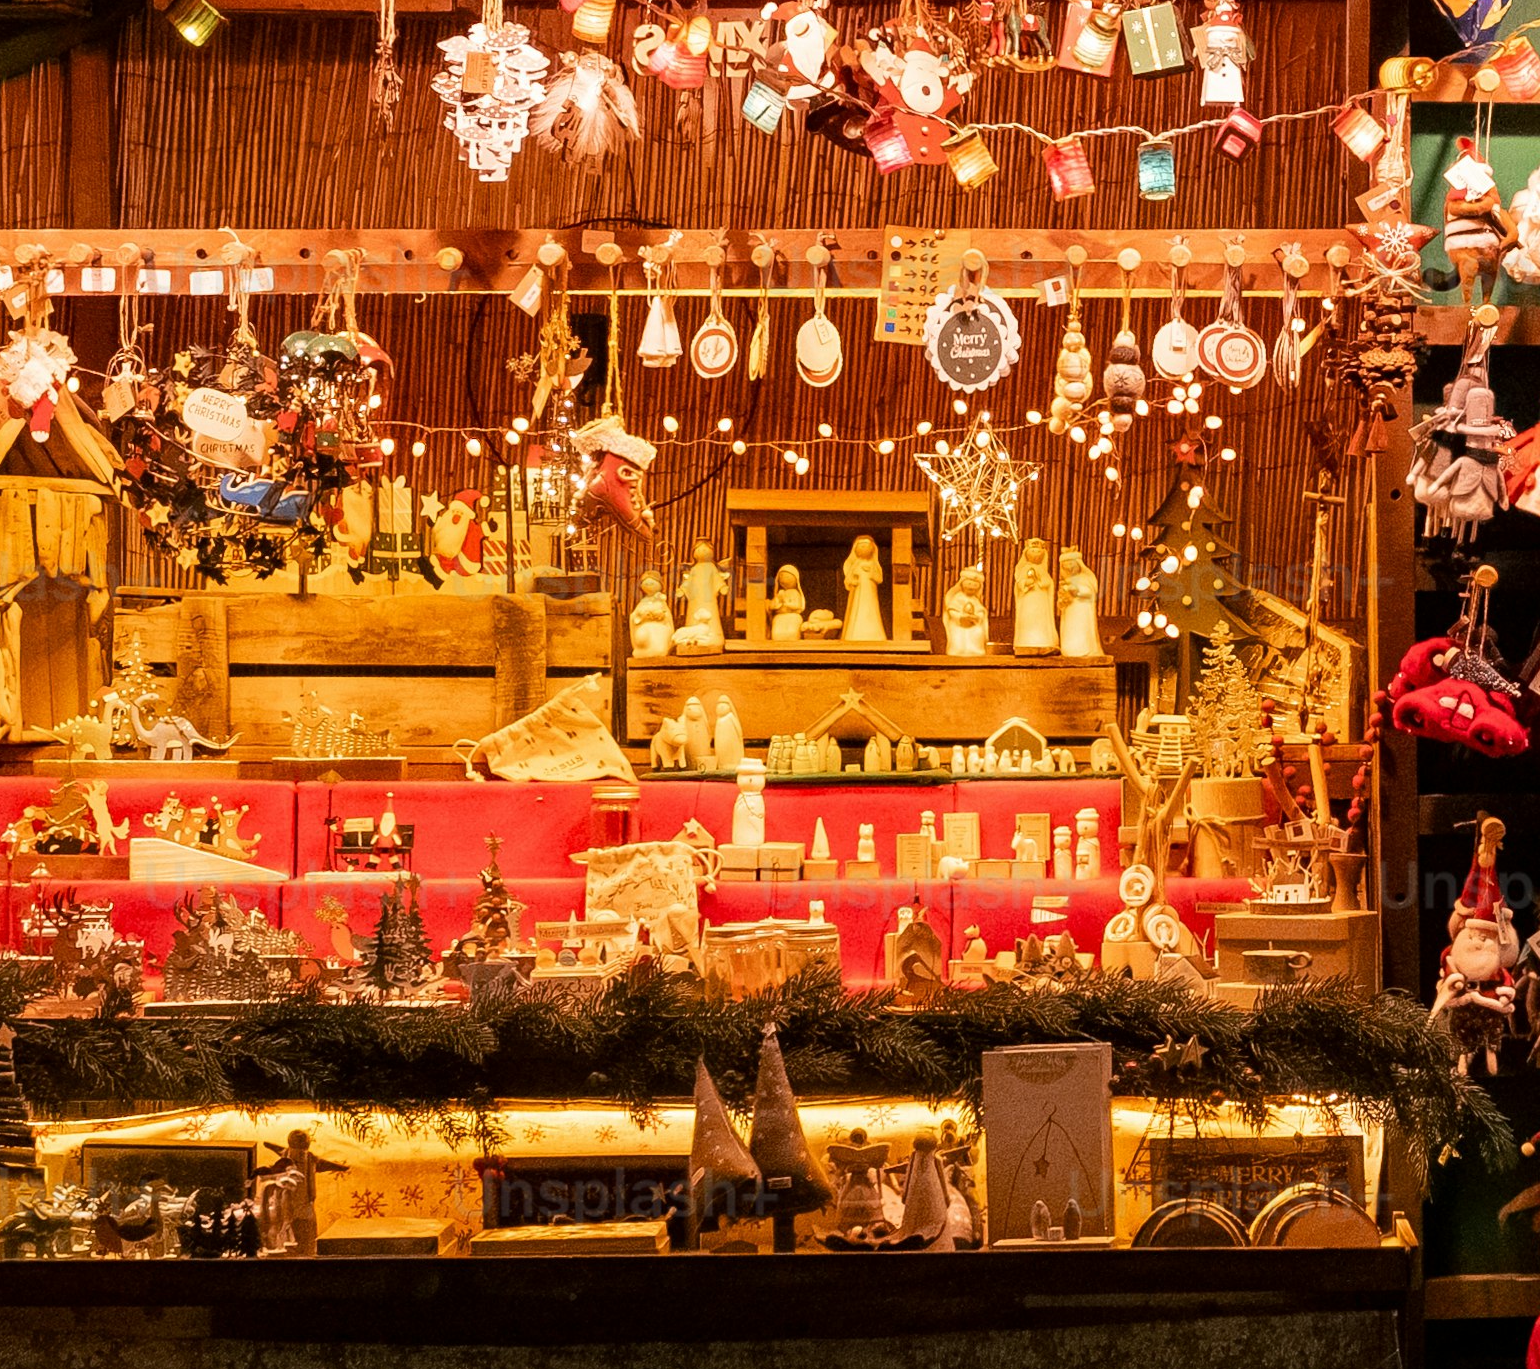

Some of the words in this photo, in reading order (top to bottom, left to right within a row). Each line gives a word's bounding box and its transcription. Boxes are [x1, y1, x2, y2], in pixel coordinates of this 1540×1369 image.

[953, 333, 987, 347] Merry
[188, 403, 241, 429] CHRISTMAS
[200, 443, 255, 453] CHRISTMAS
